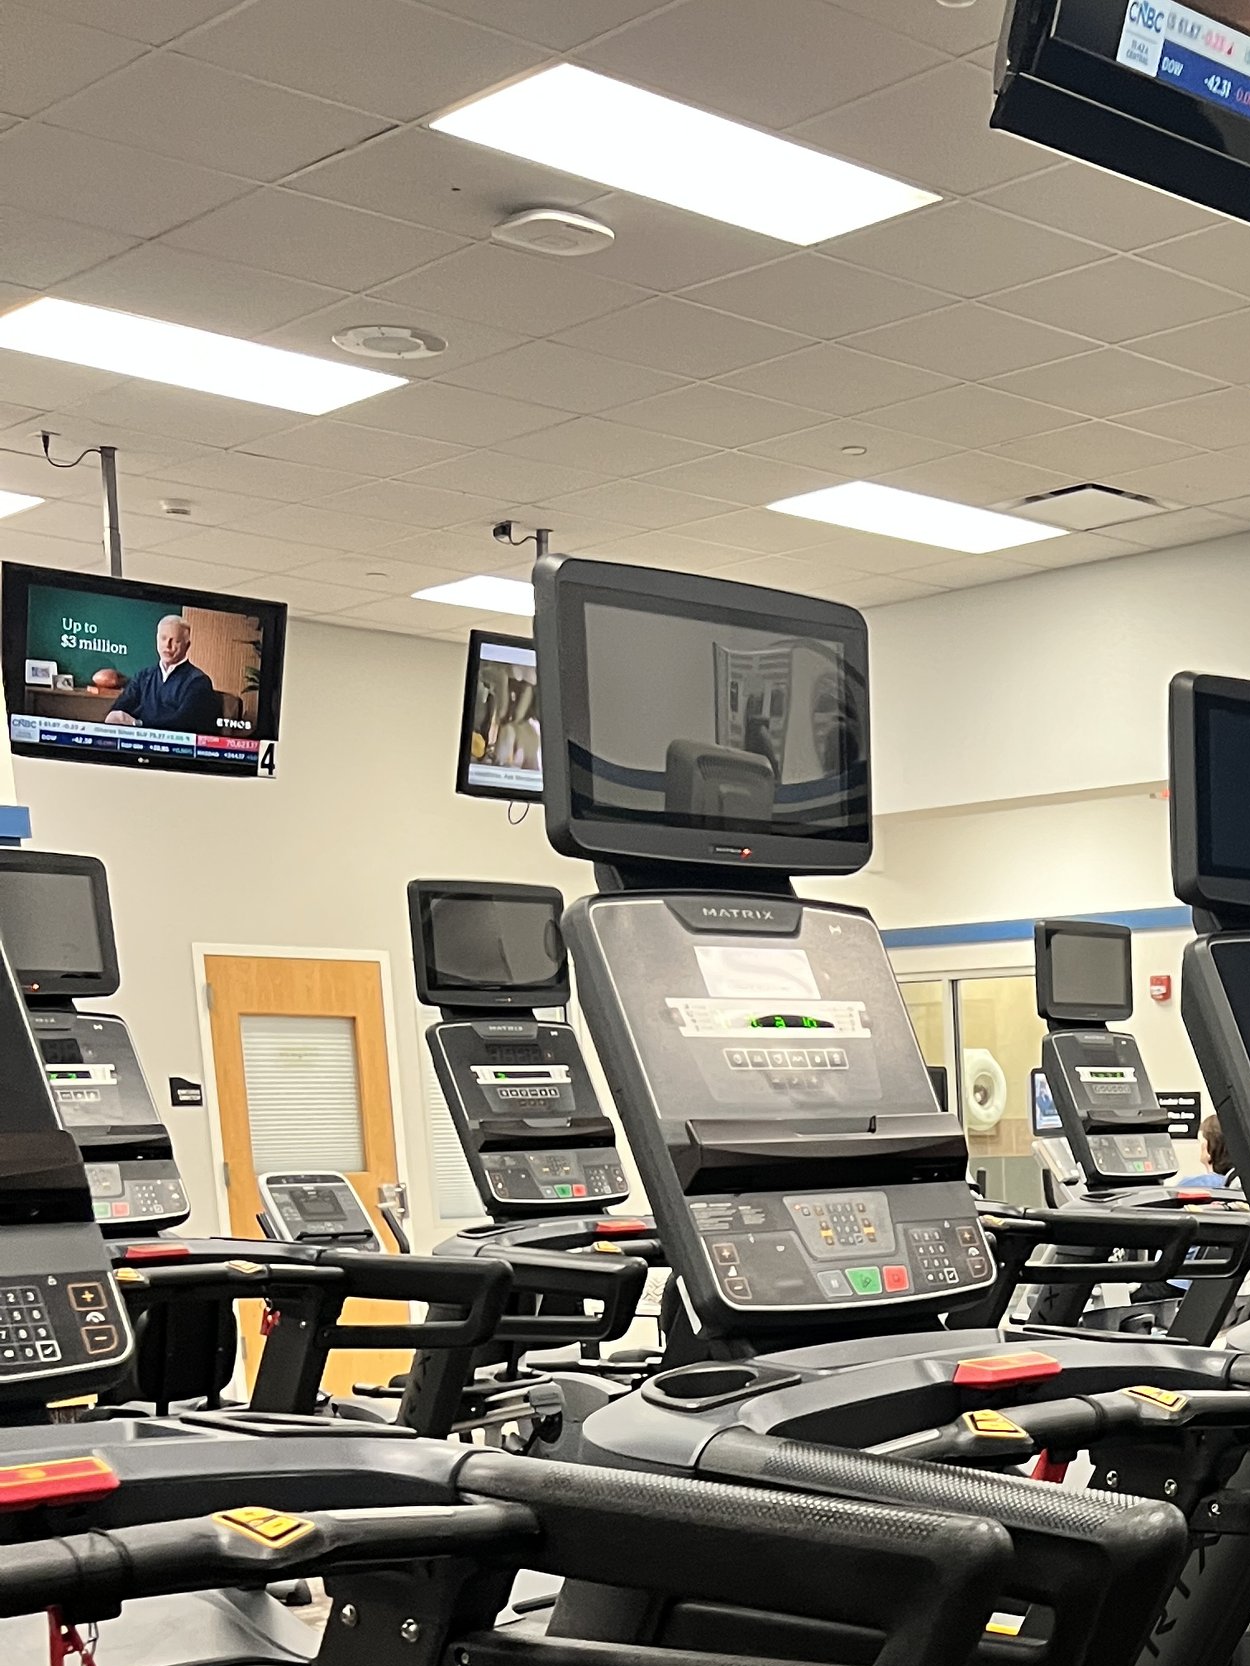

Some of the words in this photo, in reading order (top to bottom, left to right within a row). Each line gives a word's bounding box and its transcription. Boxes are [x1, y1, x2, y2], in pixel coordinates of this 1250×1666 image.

[1129, 1, 1165, 33] CNBC
[1161, 56, 1184, 77] DOW
[62, 617, 82, 634] Up
[84, 622, 98, 634] to
[61, 634, 77, 648] $3
[79, 638, 127, 655] million
[216, 717, 252, 730] ETHOS
[260, 742, 276, 775] 4
[702, 907, 774, 920] MATRIX
